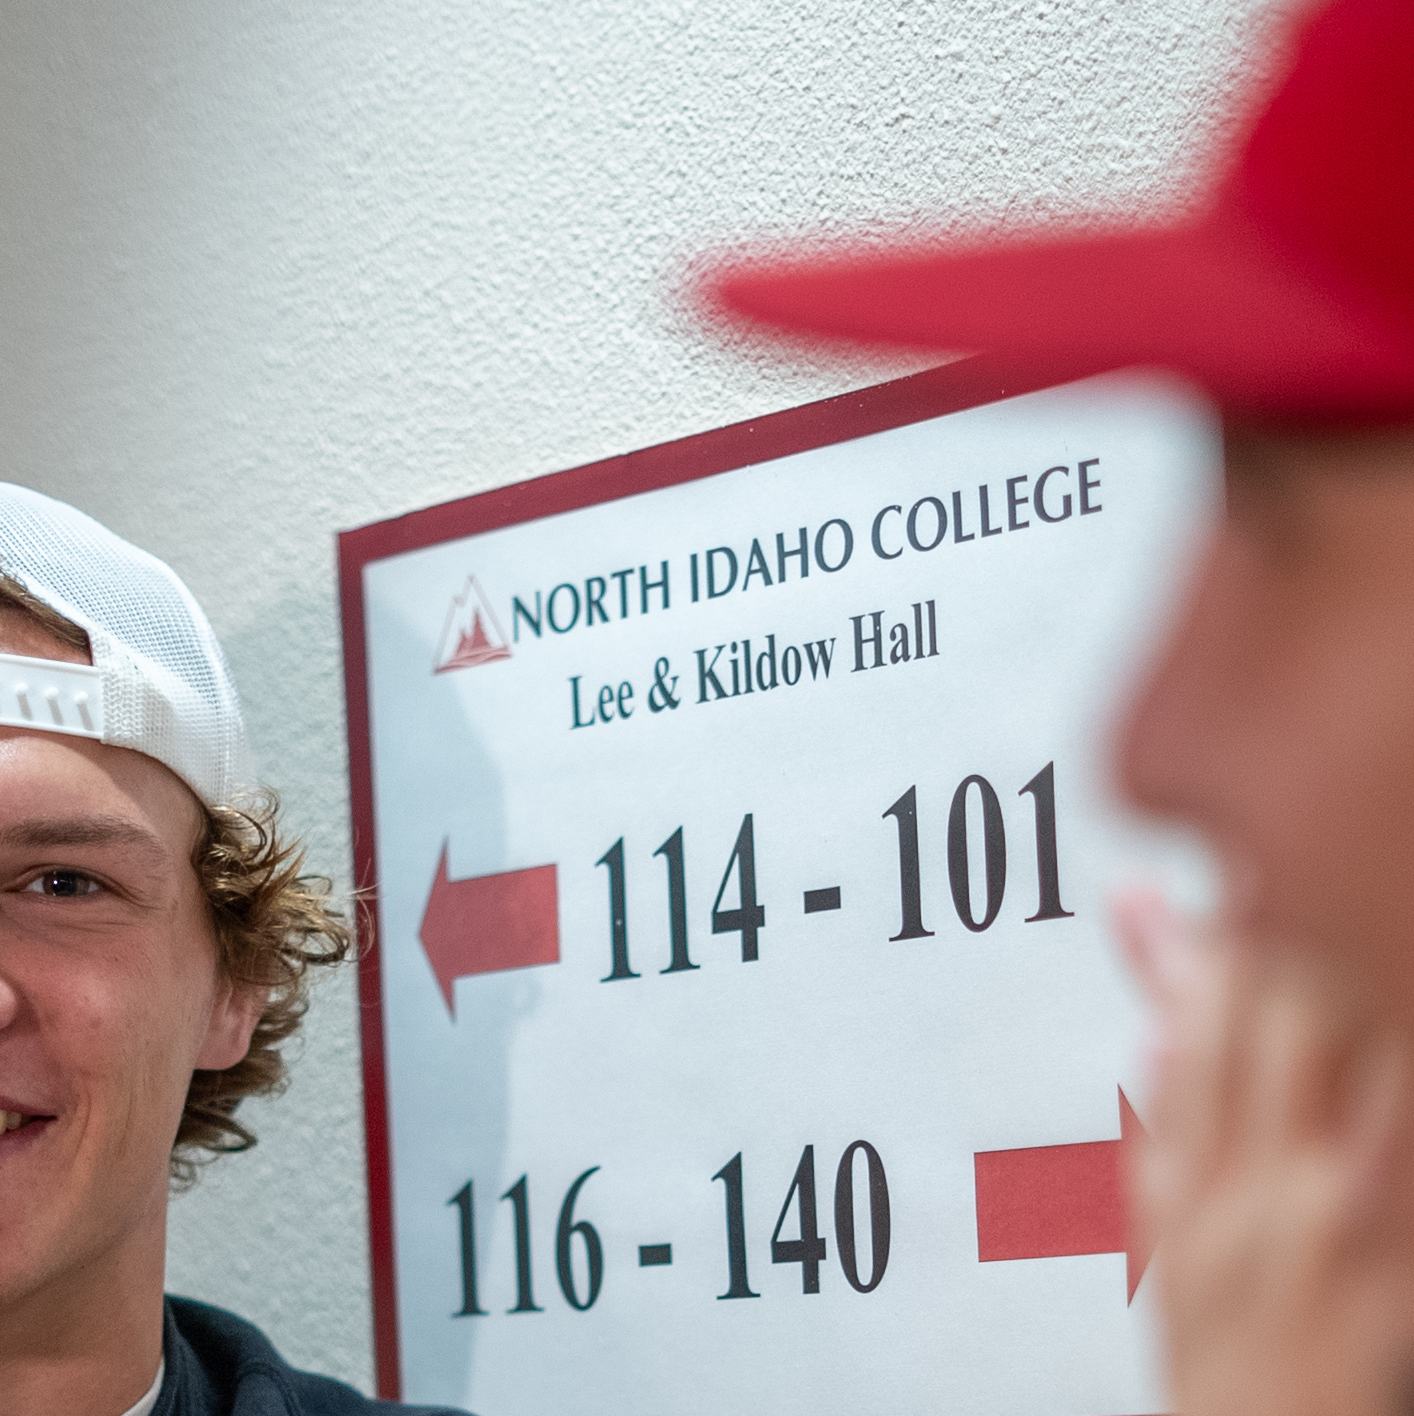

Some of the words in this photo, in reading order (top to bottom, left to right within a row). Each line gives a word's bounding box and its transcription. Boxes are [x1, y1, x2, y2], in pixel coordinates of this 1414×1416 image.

[510, 560, 671, 645] NORTH
[689, 518, 855, 604] IDAHO
[871, 457, 1104, 561] COLLEGE
[568, 674, 635, 730] Lee
[648, 655, 681, 713] &
[693, 633, 837, 705] Kildow
[848, 599, 940, 674] Hall
[594, 813, 767, 983] 114
[803, 885, 843, 914] -
[880, 760, 1076, 943] 101
[446, 1165, 605, 1317] 116
[638, 1243, 673, 1268] -
[710, 1139, 892, 1301] 140
